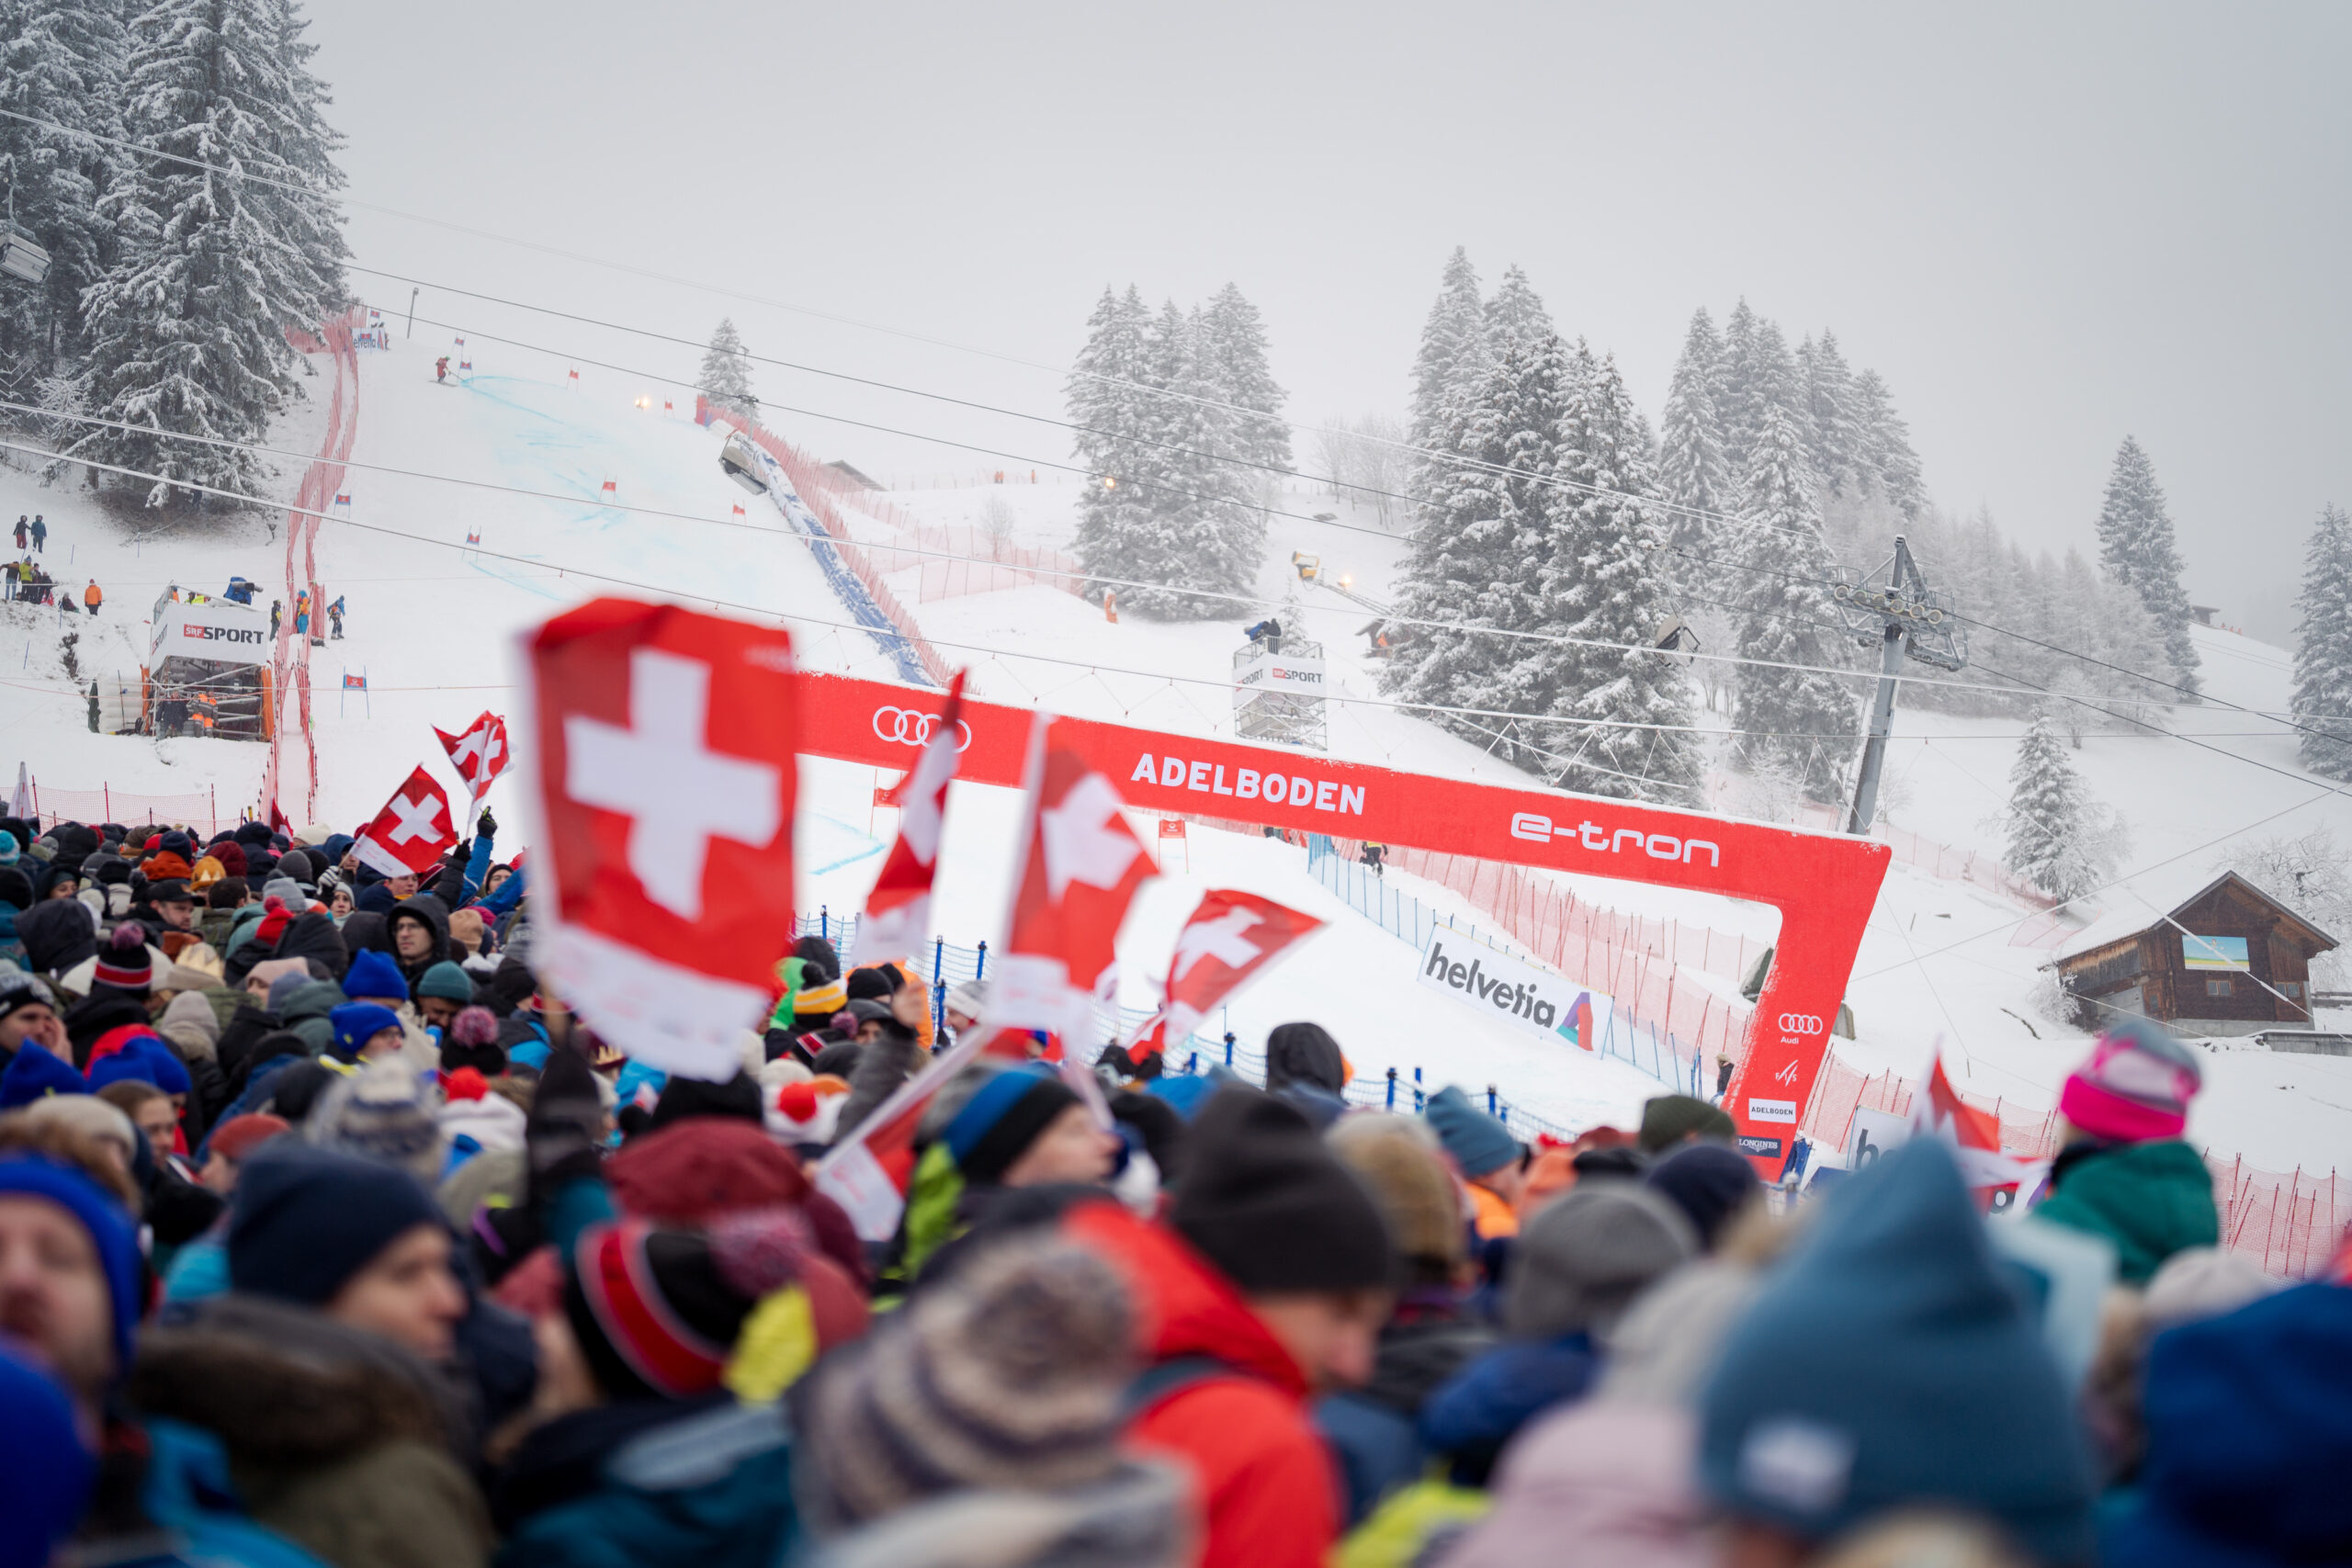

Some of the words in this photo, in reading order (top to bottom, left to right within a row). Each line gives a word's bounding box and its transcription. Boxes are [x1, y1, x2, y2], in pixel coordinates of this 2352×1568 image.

[185, 626, 203, 637] SRF
[203, 626, 264, 644] SPORT
[1285, 670, 1323, 683] SPORT
[1130, 753, 1365, 815] ADELBODEN
[1510, 812, 1720, 867] e-tron
[1426, 942, 1555, 1029] helvetia
[1781, 1036, 1799, 1044] Audi
[1751, 1106, 1793, 1116] ADELBODEN
[1738, 1138, 1779, 1149] LONGINES
